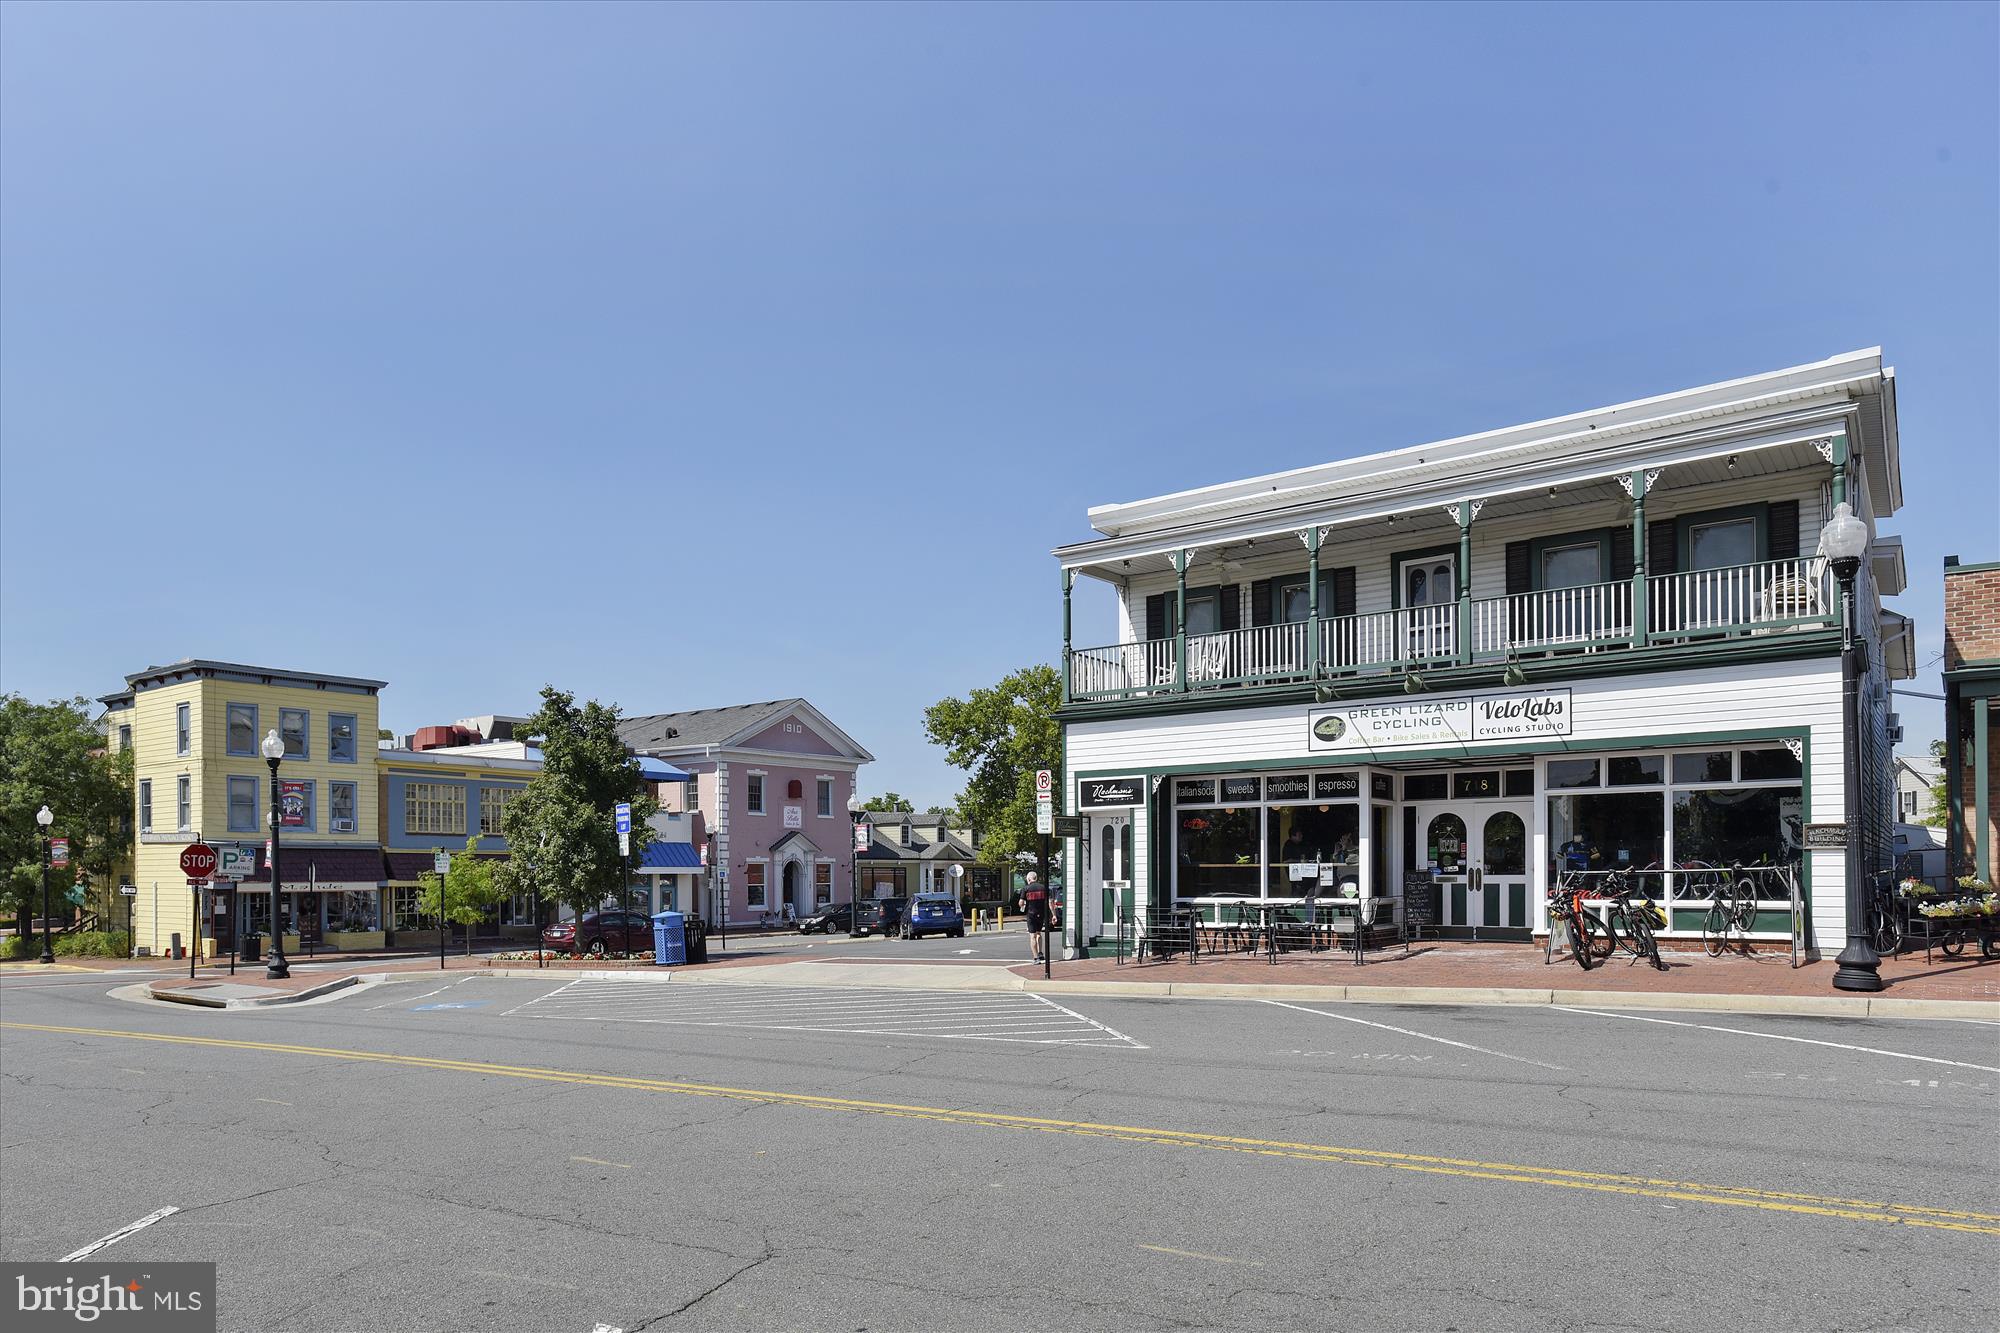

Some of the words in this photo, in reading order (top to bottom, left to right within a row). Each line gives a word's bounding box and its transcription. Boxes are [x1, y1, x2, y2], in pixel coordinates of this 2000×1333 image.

[1349, 707, 1402, 720] GREEN
[1409, 702, 1468, 715] LIZARD
[1480, 697, 1563, 721] VeloLabs
[783, 723, 802, 733] 1910
[1373, 717, 1442, 730] CYCLING
[1479, 725, 1521, 735] CYCLING
[1525, 723, 1564, 733] STUDIO
[1372, 735, 1385, 743] Bar
[1393, 734, 1409, 742] Bike
[1410, 732, 1430, 741] Sales
[1227, 784, 1254, 795] sweets
[1268, 780, 1308, 793] smoothies
[1318, 779, 1357, 791] espresso
[182, 854, 214, 868] STOP
